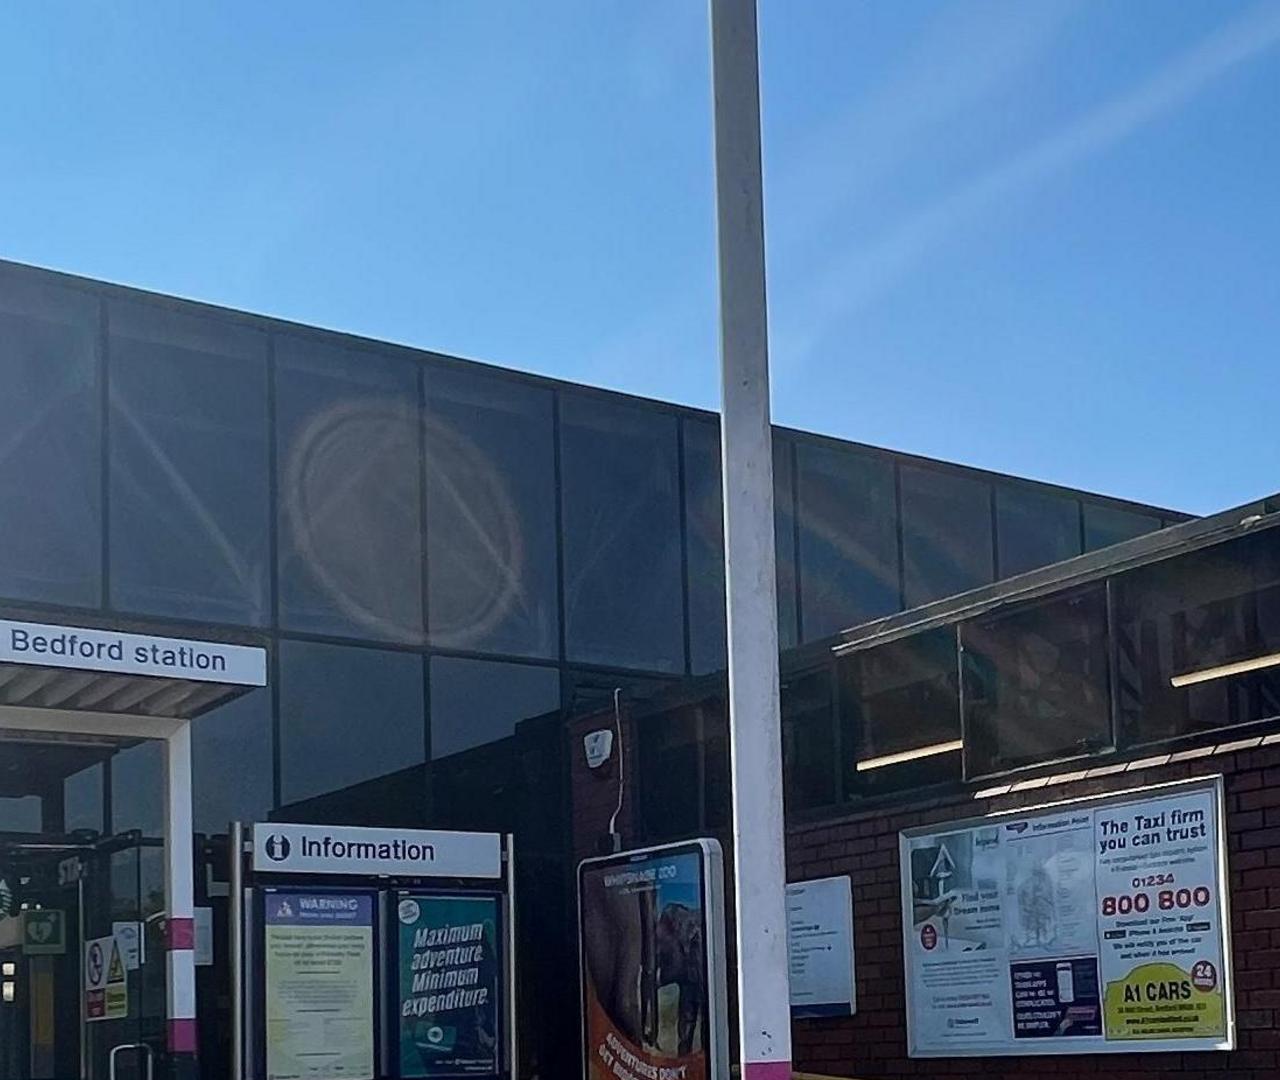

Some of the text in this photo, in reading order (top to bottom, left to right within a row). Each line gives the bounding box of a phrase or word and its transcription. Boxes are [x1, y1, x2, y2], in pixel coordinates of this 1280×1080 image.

[11, 628, 123, 662] Bedford
[134, 644, 226, 672] station
[1100, 809, 1204, 836] The Taxi firm
[302, 836, 435, 861] Information
[1099, 837, 1126, 855] you
[1132, 832, 1161, 847] can
[1166, 822, 1207, 842] trust
[1132, 873, 1175, 889] 01234
[299, 898, 359, 911] WARNING
[1102, 886, 1210, 916] 800 800
[413, 923, 483, 949] Maximum
[412, 945, 484, 970] adventure.
[412, 967, 479, 993] Minimum
[1124, 980, 1192, 1003] A1 CARS
